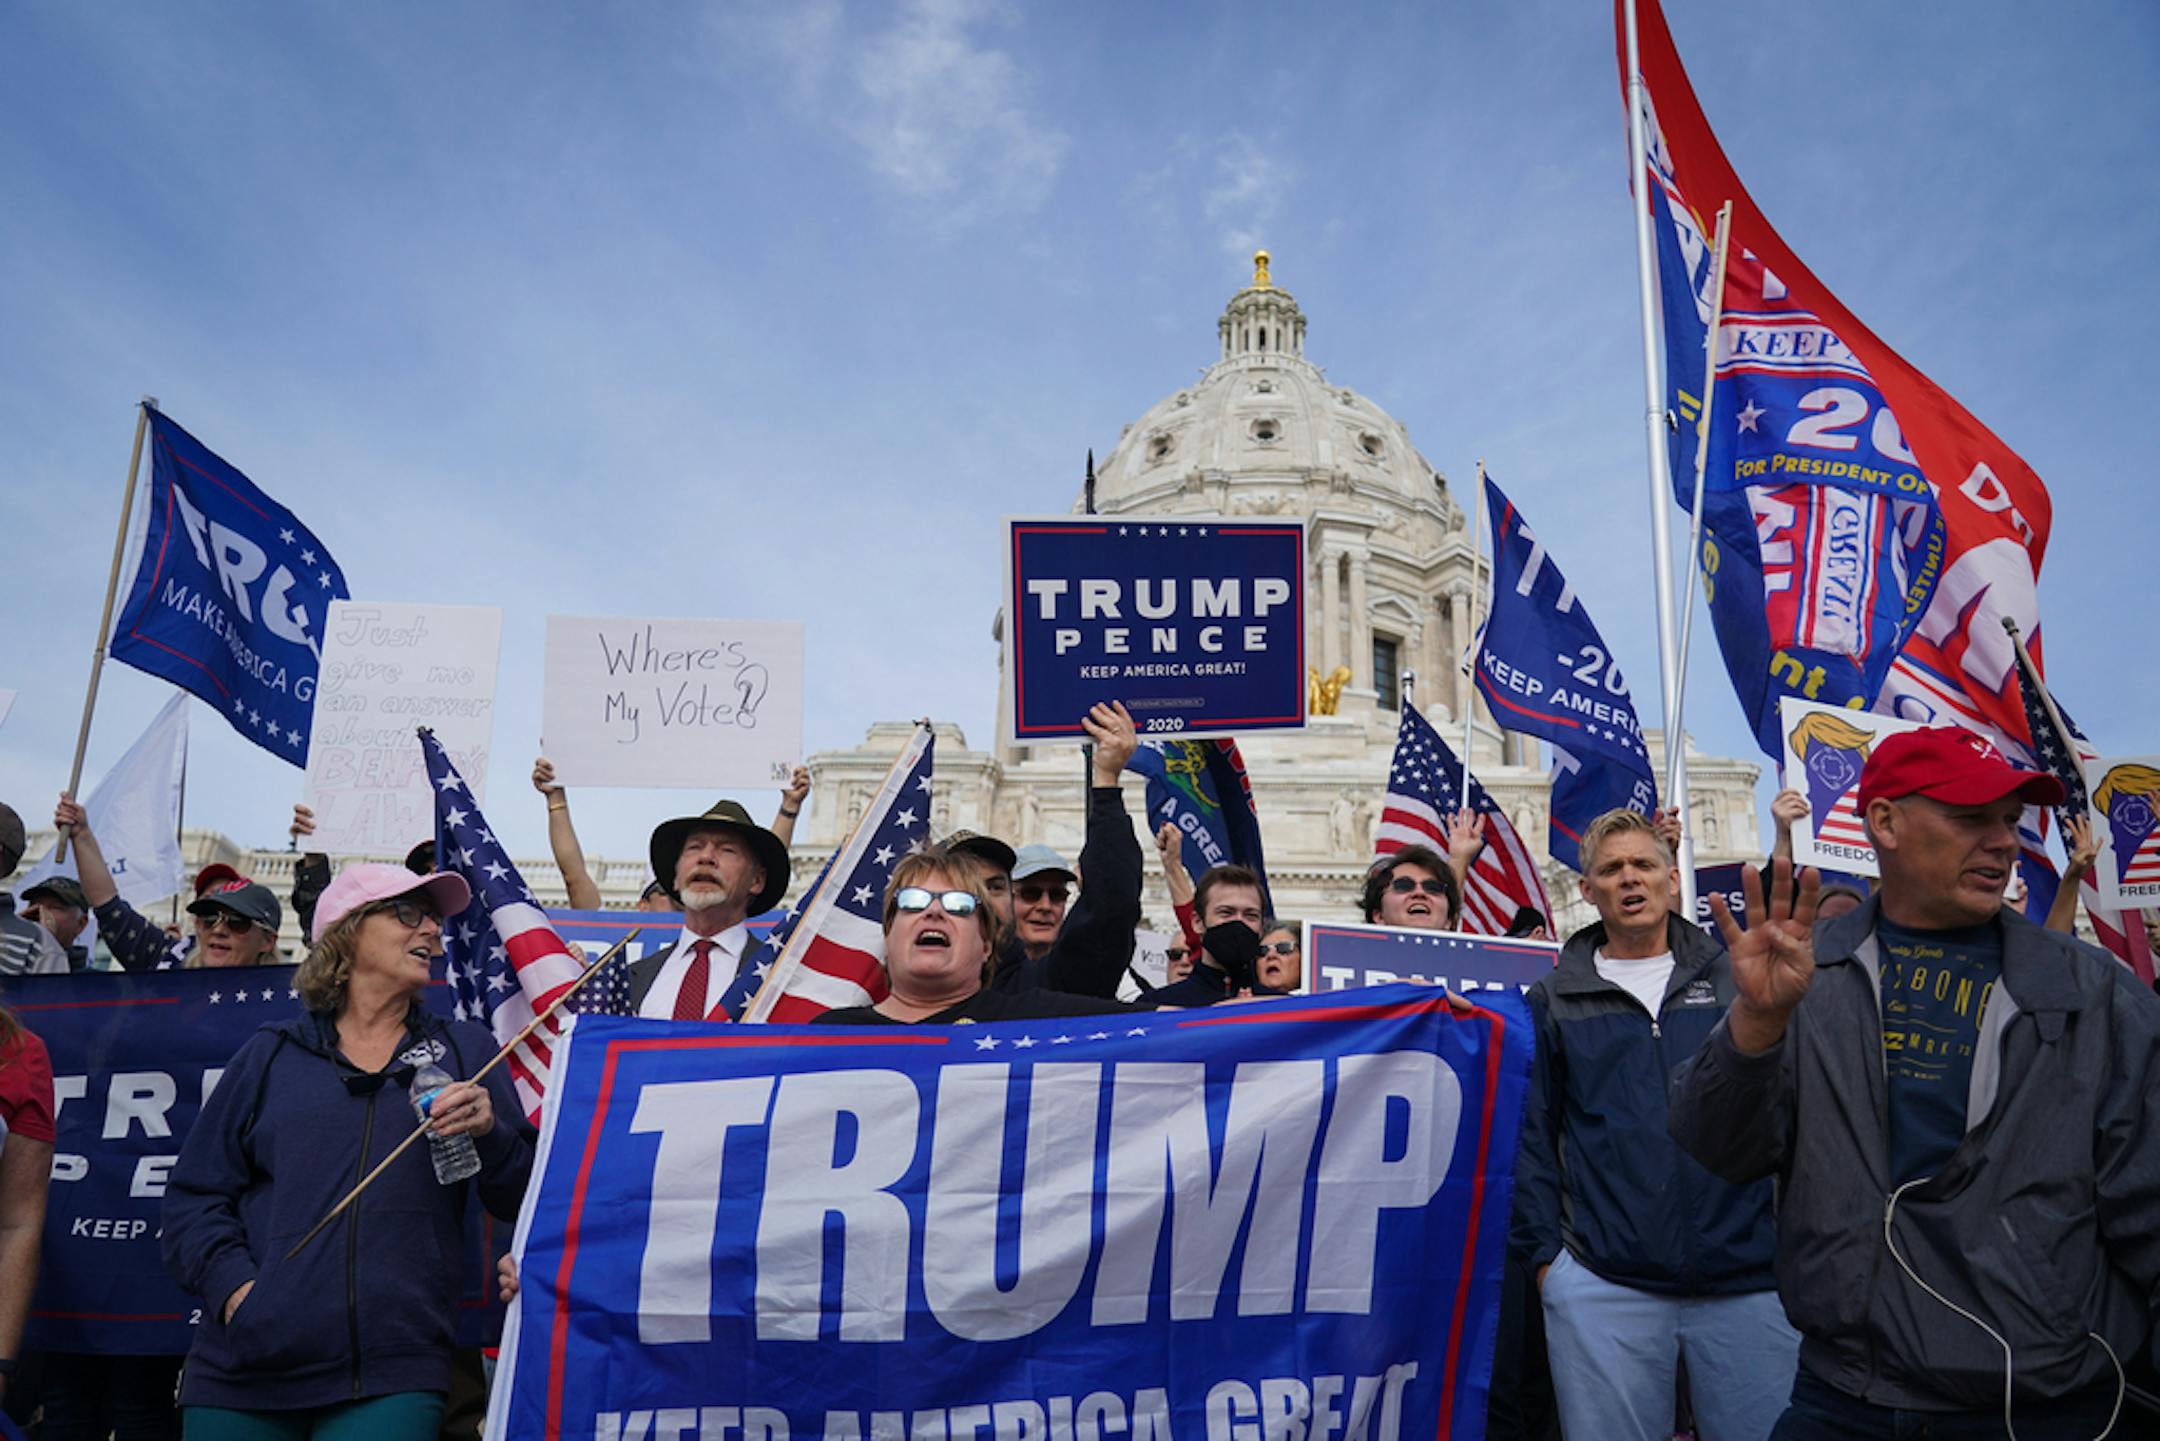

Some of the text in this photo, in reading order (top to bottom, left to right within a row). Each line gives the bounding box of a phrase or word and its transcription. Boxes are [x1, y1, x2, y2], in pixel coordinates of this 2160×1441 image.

[1735, 330, 1840, 357] KEEP
[1771, 454, 1892, 485] PRESIDENT
[161, 577, 226, 636] MAKE
[1027, 578, 1291, 619] TRUMP
[336, 609, 429, 646] Just
[1055, 626, 1268, 655] PENCE
[599, 624, 746, 676] Where's
[321, 655, 476, 694] give me
[1080, 662, 1247, 679] KEEP AMERICA GREAT!
[1483, 649, 1544, 696] KEEP
[322, 694, 491, 718] an answer
[604, 691, 641, 744] My
[315, 716, 419, 748] about
[1146, 717, 1185, 731] 2020
[2119, 884, 2160, 896] FREE
[629, 1049, 1464, 1344] TRUMP
[71, 1216, 147, 1240] KEEP
